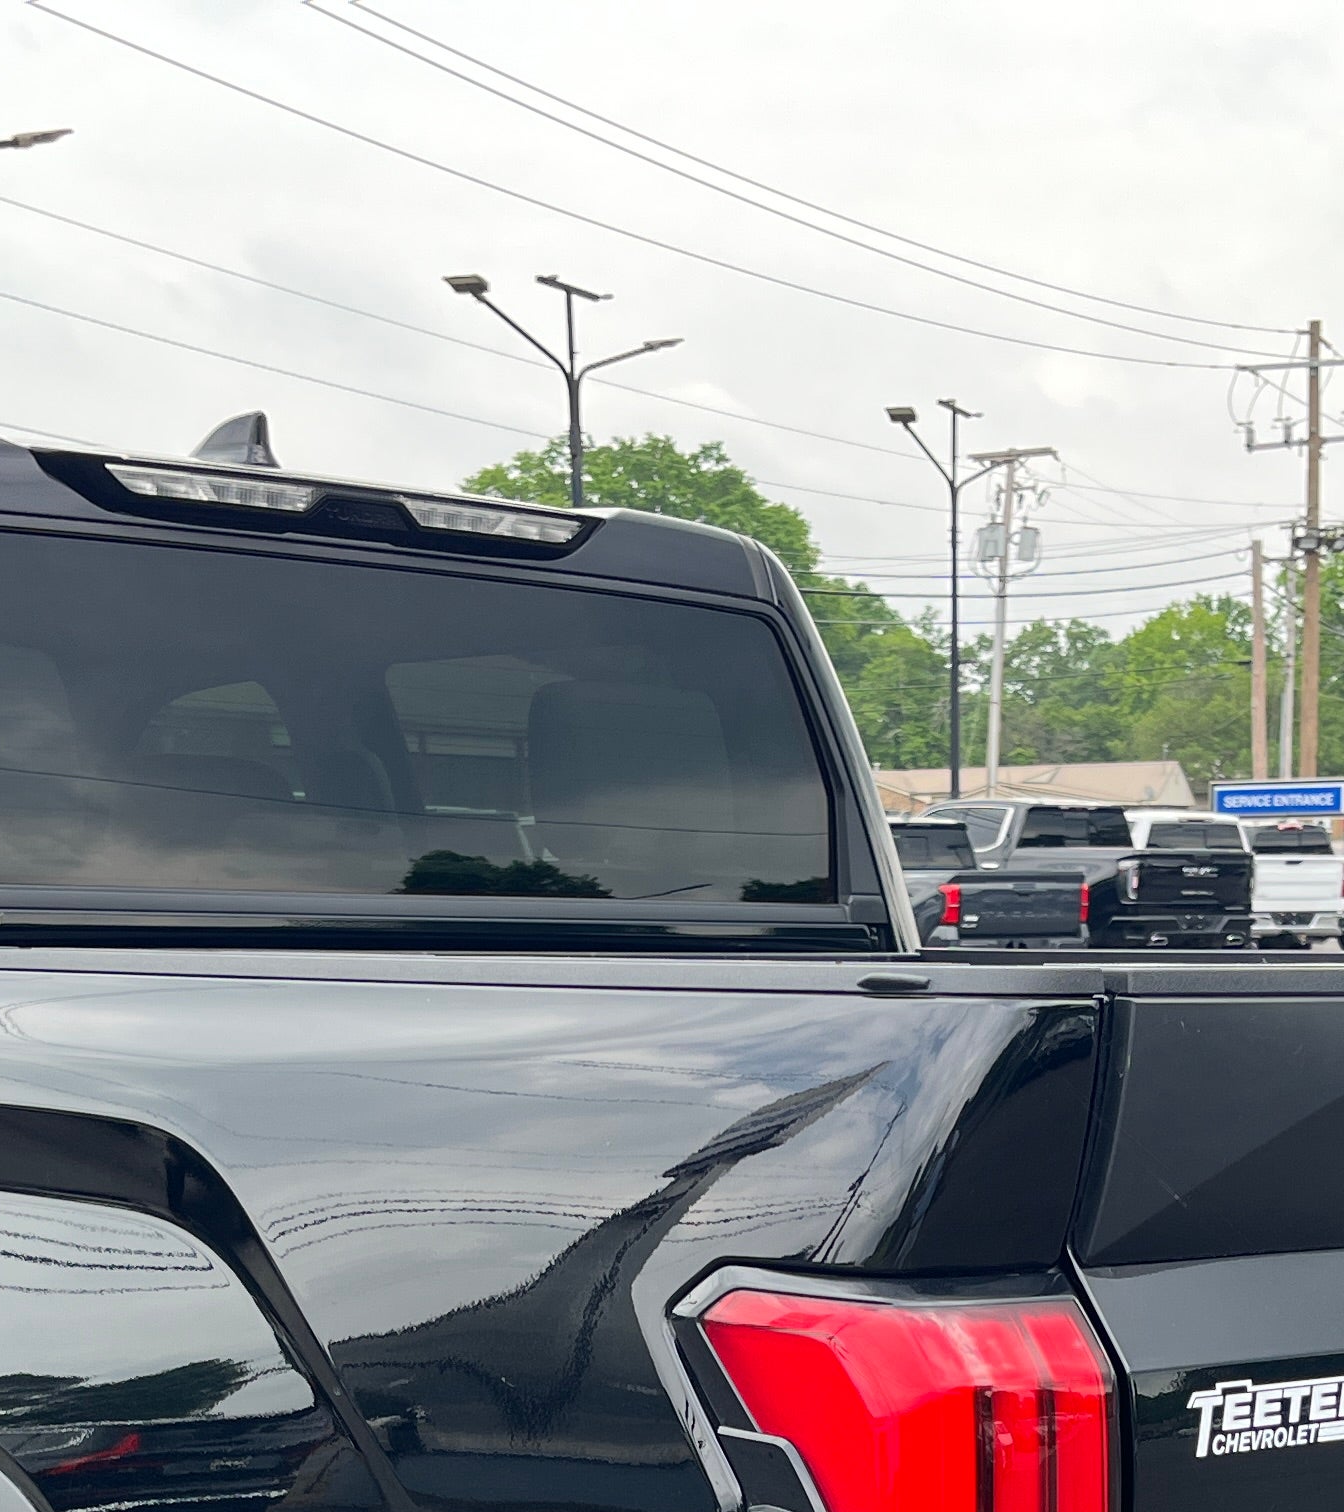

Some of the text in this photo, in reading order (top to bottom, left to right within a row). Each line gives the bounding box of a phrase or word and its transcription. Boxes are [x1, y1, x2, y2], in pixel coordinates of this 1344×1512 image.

[1223, 792, 1335, 808] SERVICE ENTRANCE
[1212, 1423, 1320, 1456] CHEVROLET
